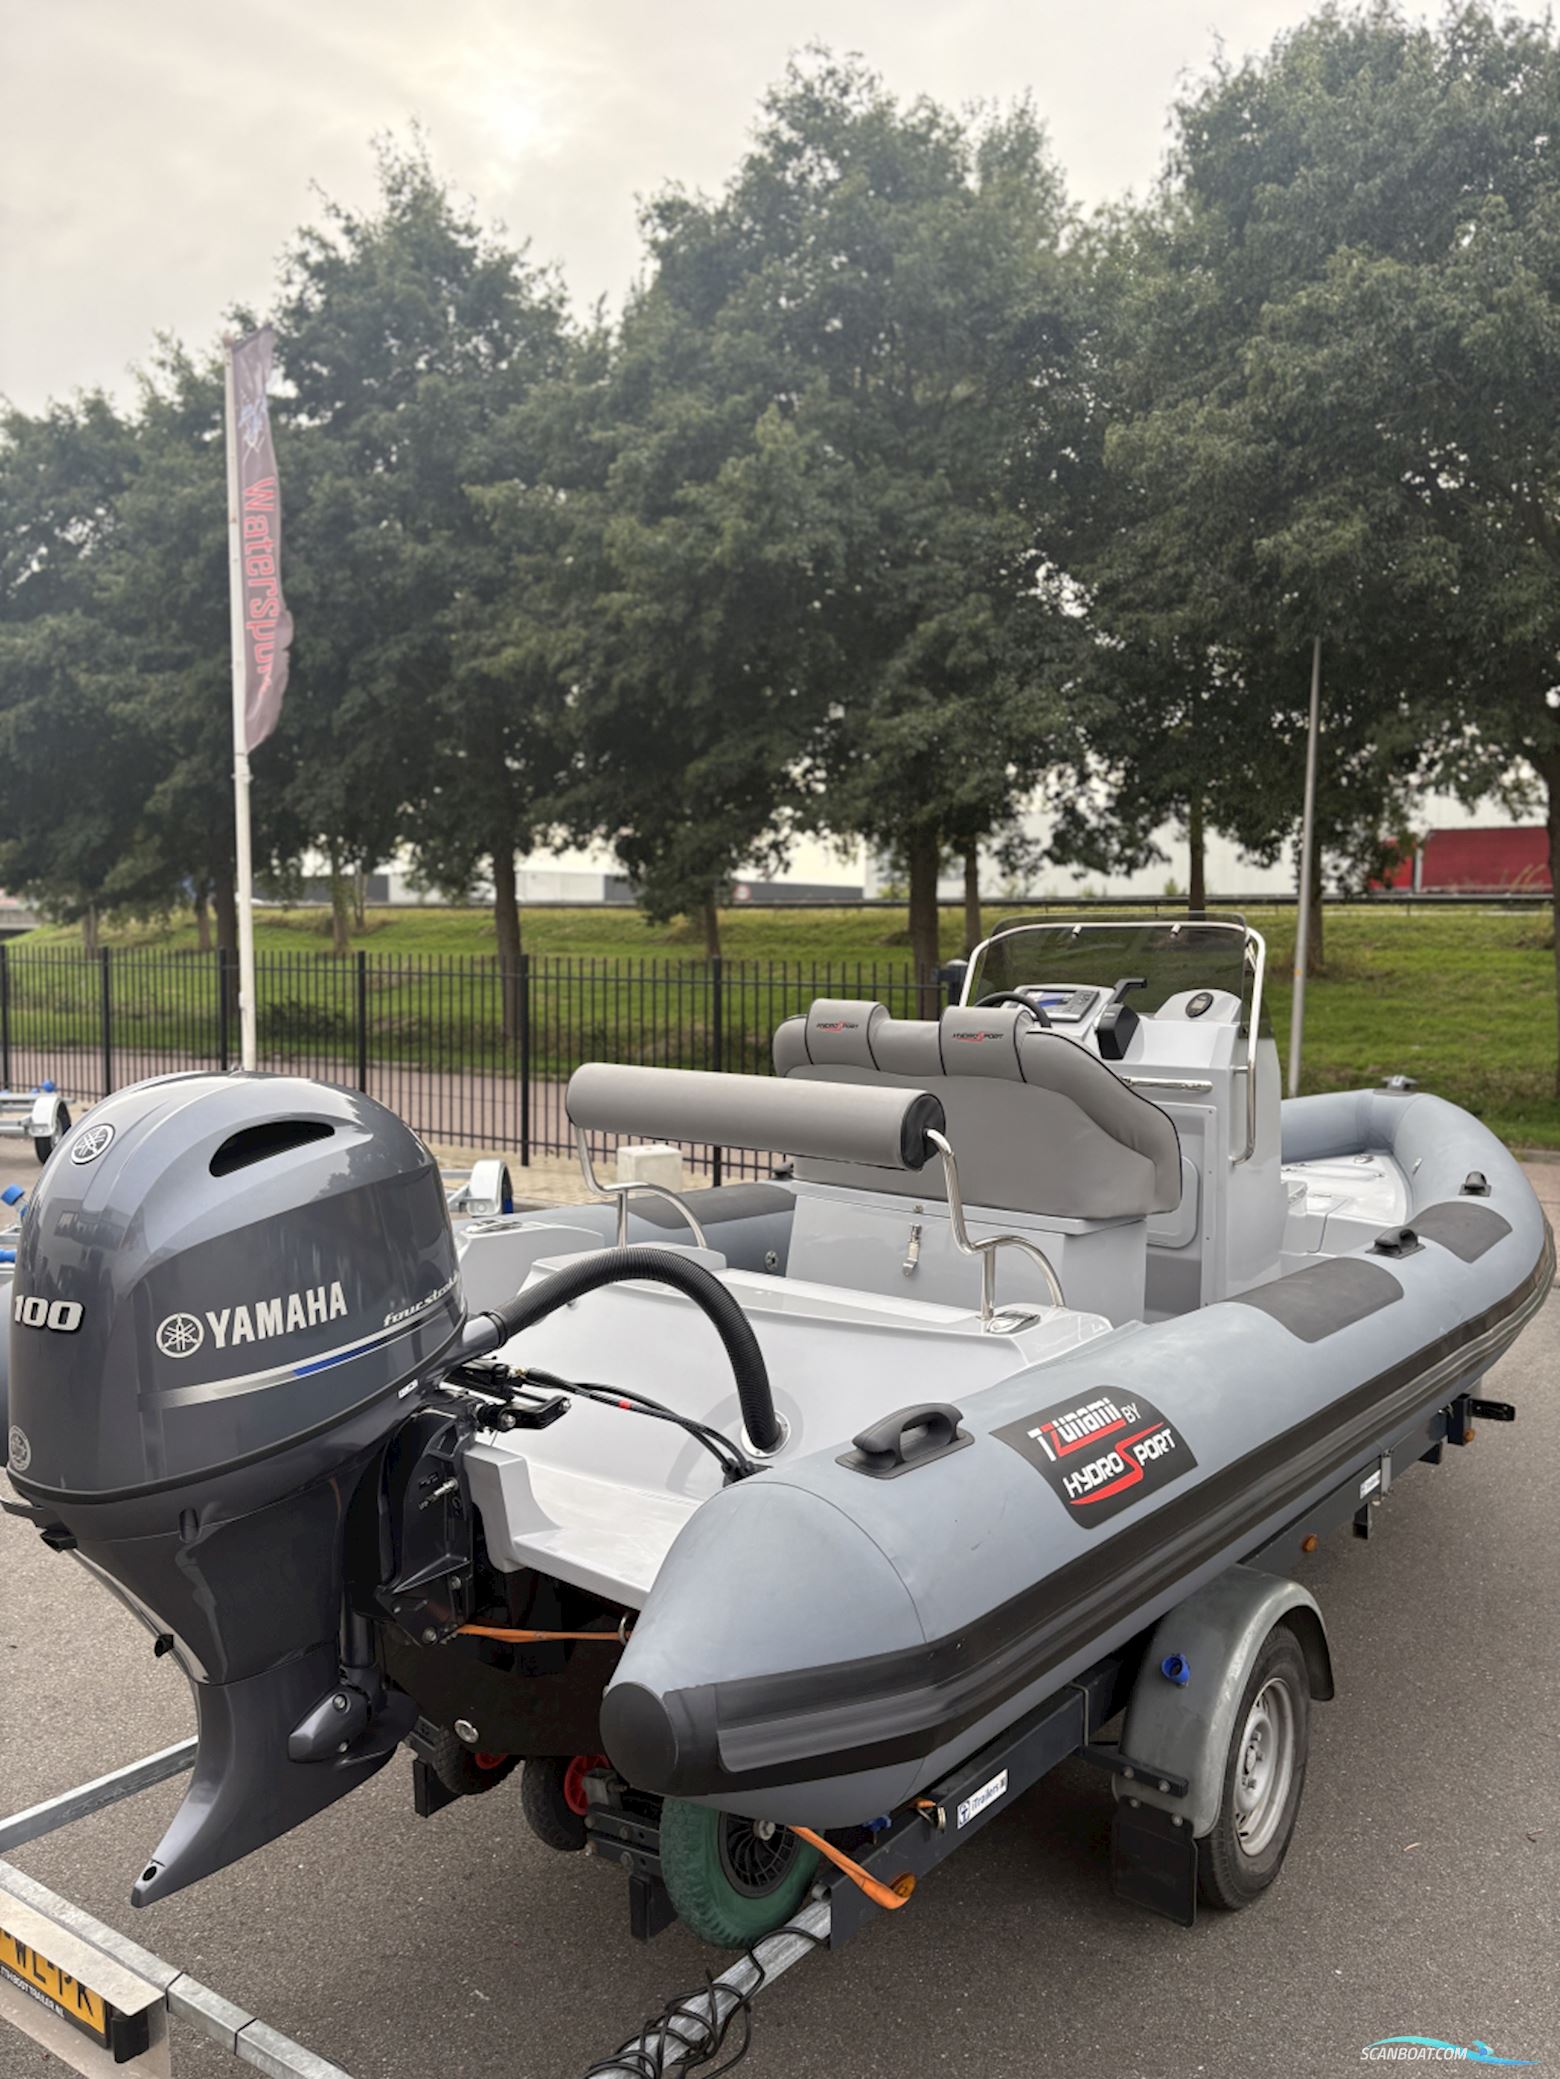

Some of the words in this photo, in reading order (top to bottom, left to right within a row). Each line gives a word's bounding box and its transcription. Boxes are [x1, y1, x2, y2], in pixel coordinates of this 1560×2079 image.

[14, 1294, 84, 1332] 100
[205, 1281, 348, 1349] YAMAHA
[1120, 1402, 1142, 1424] BY
